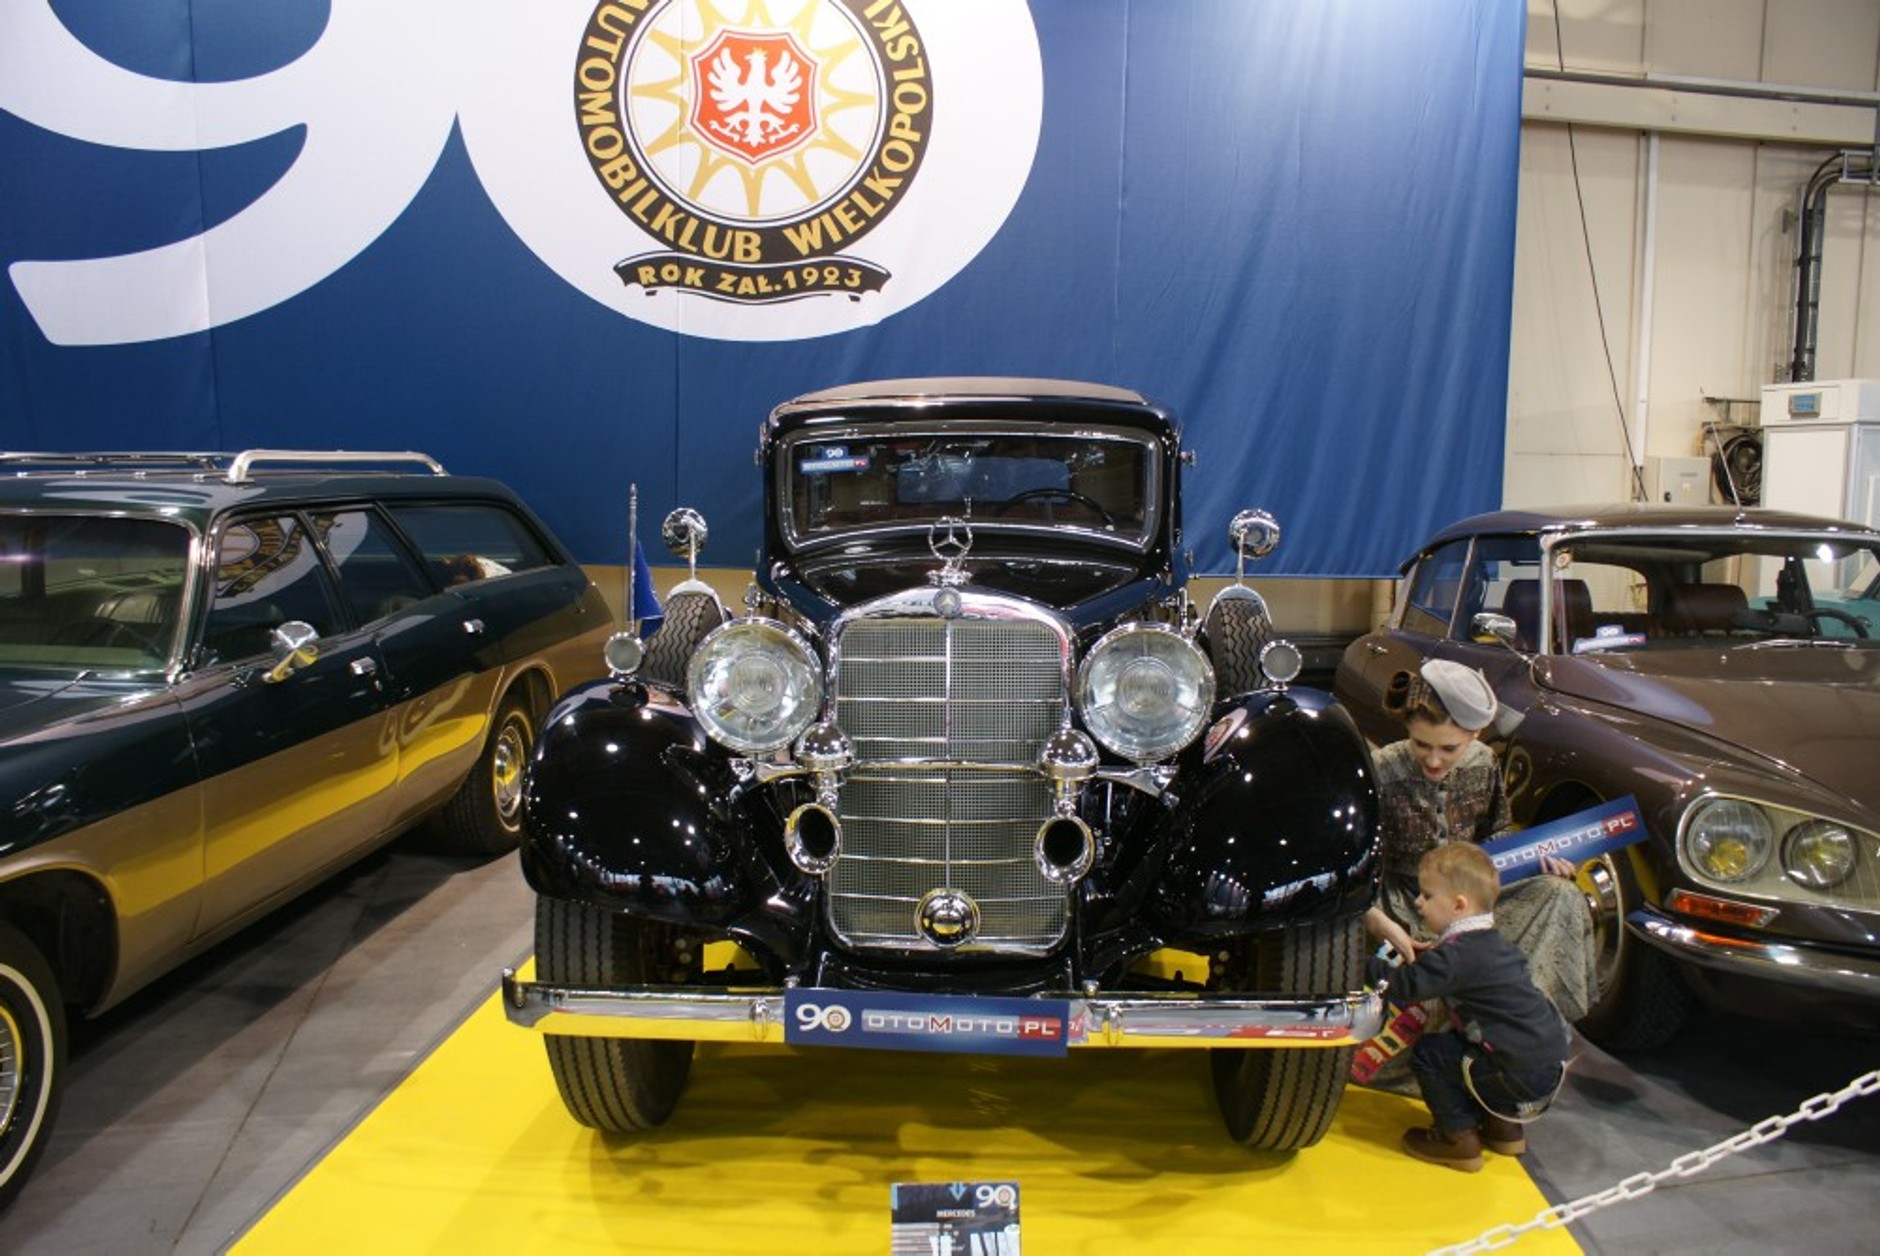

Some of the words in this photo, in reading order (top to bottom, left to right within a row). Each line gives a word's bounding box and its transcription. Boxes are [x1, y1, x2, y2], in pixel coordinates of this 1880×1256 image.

[783, 0, 928, 256] WIELKOPOLSKI
[637, 263, 705, 287] ROK
[795, 1003, 851, 1032] 90
[867, 1014, 1056, 1036] OTOMOTO.PL
